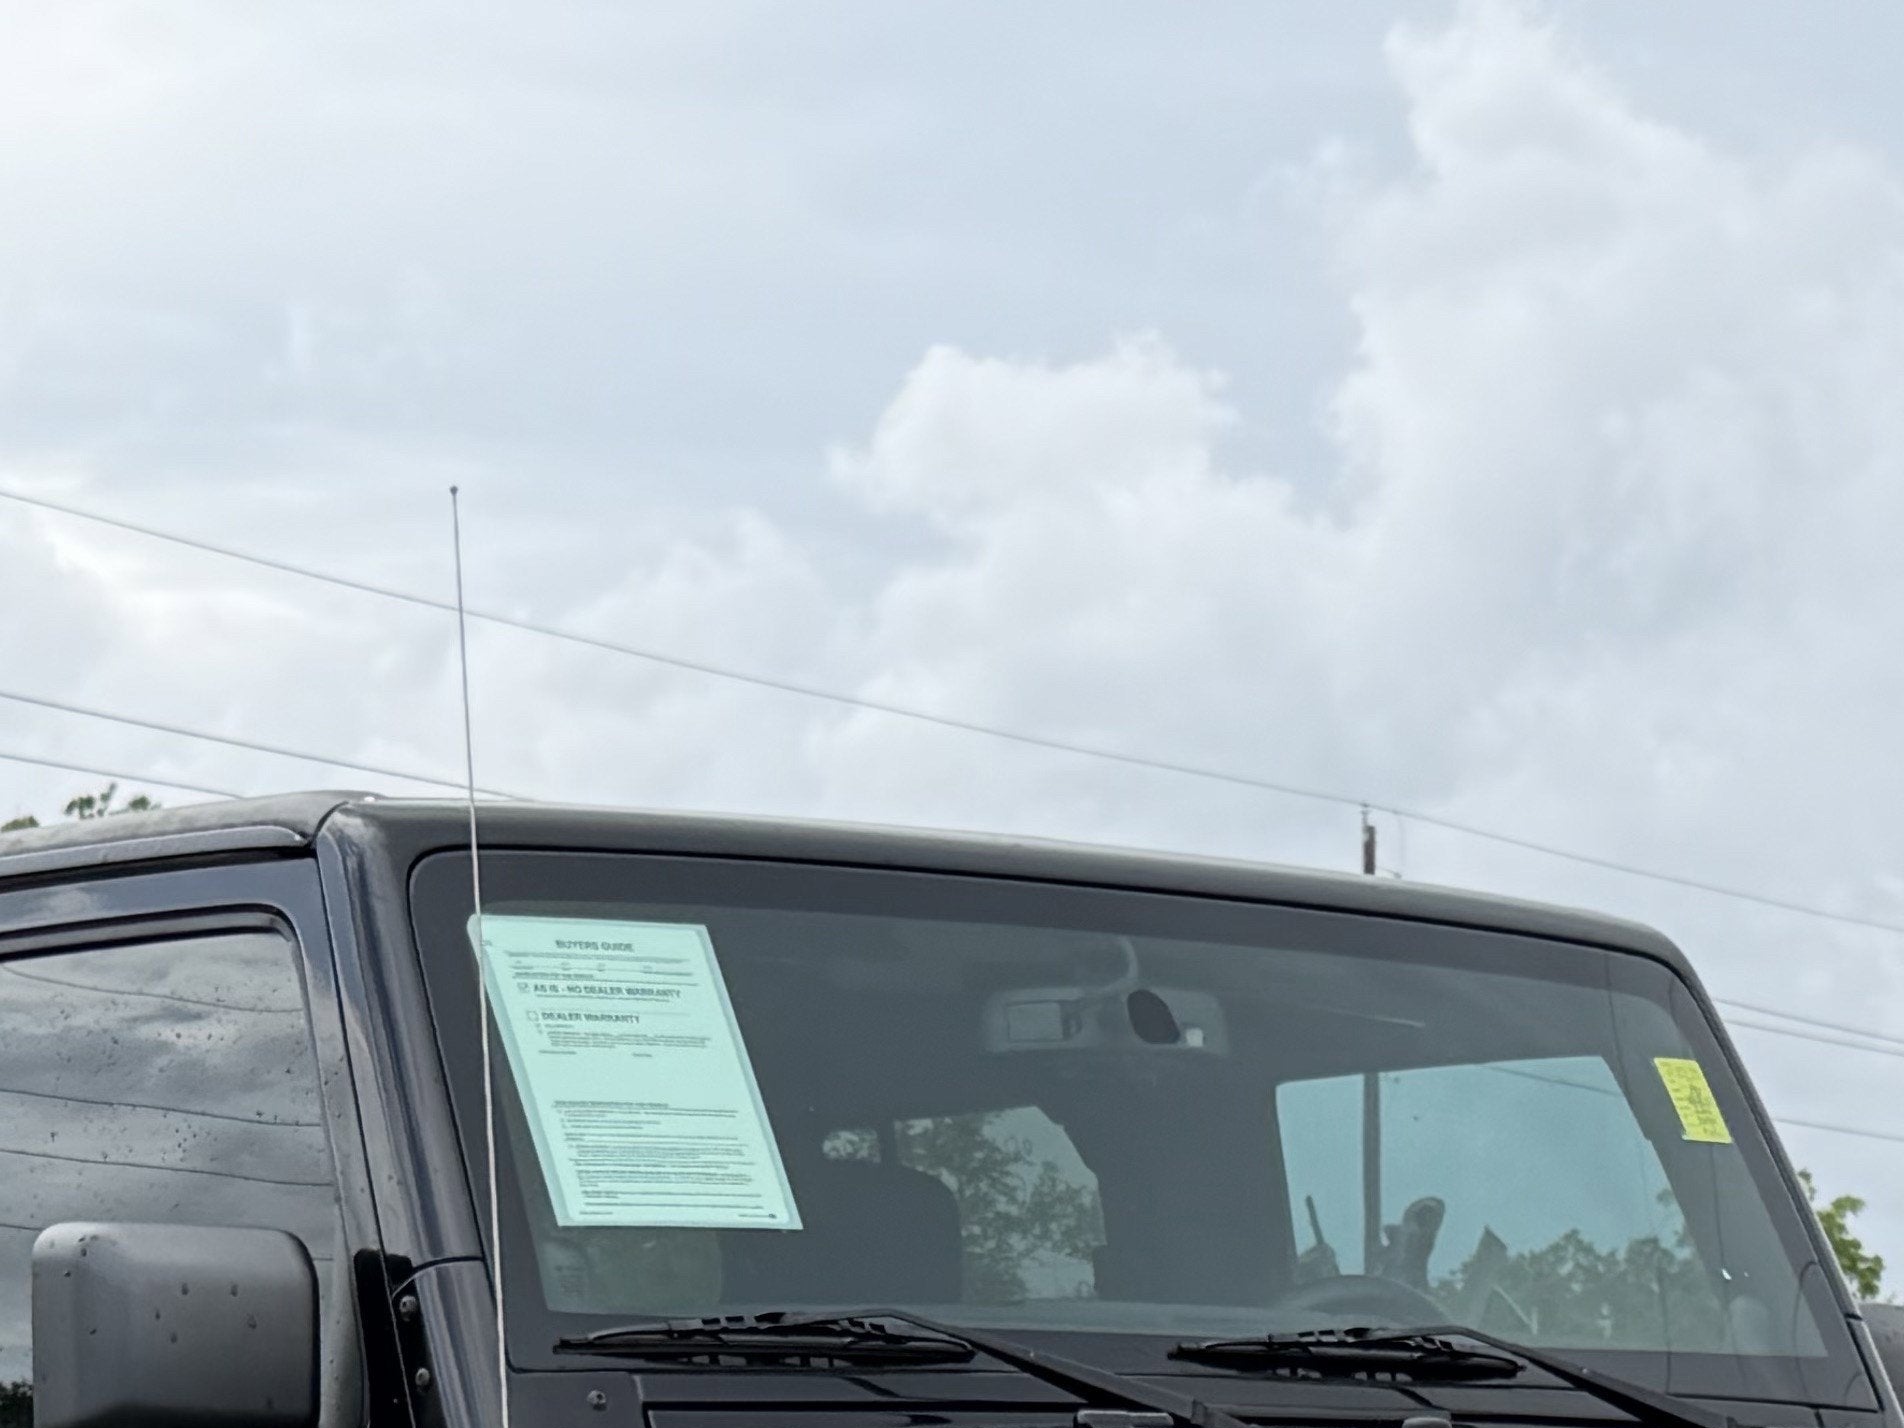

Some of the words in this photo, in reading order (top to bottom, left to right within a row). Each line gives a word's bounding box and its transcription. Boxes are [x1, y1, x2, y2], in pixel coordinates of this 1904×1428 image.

[555, 939, 599, 951] BUYERS
[601, 941, 635, 952] GUIDE
[534, 984, 548, 993] AS
[549, 984, 559, 993] IS
[566, 985, 582, 994] NO
[584, 986, 623, 995] DEALER
[625, 987, 681, 998] WARRANTY
[541, 1012, 582, 1021] DEALER
[584, 1013, 640, 1023] WARRANTY
